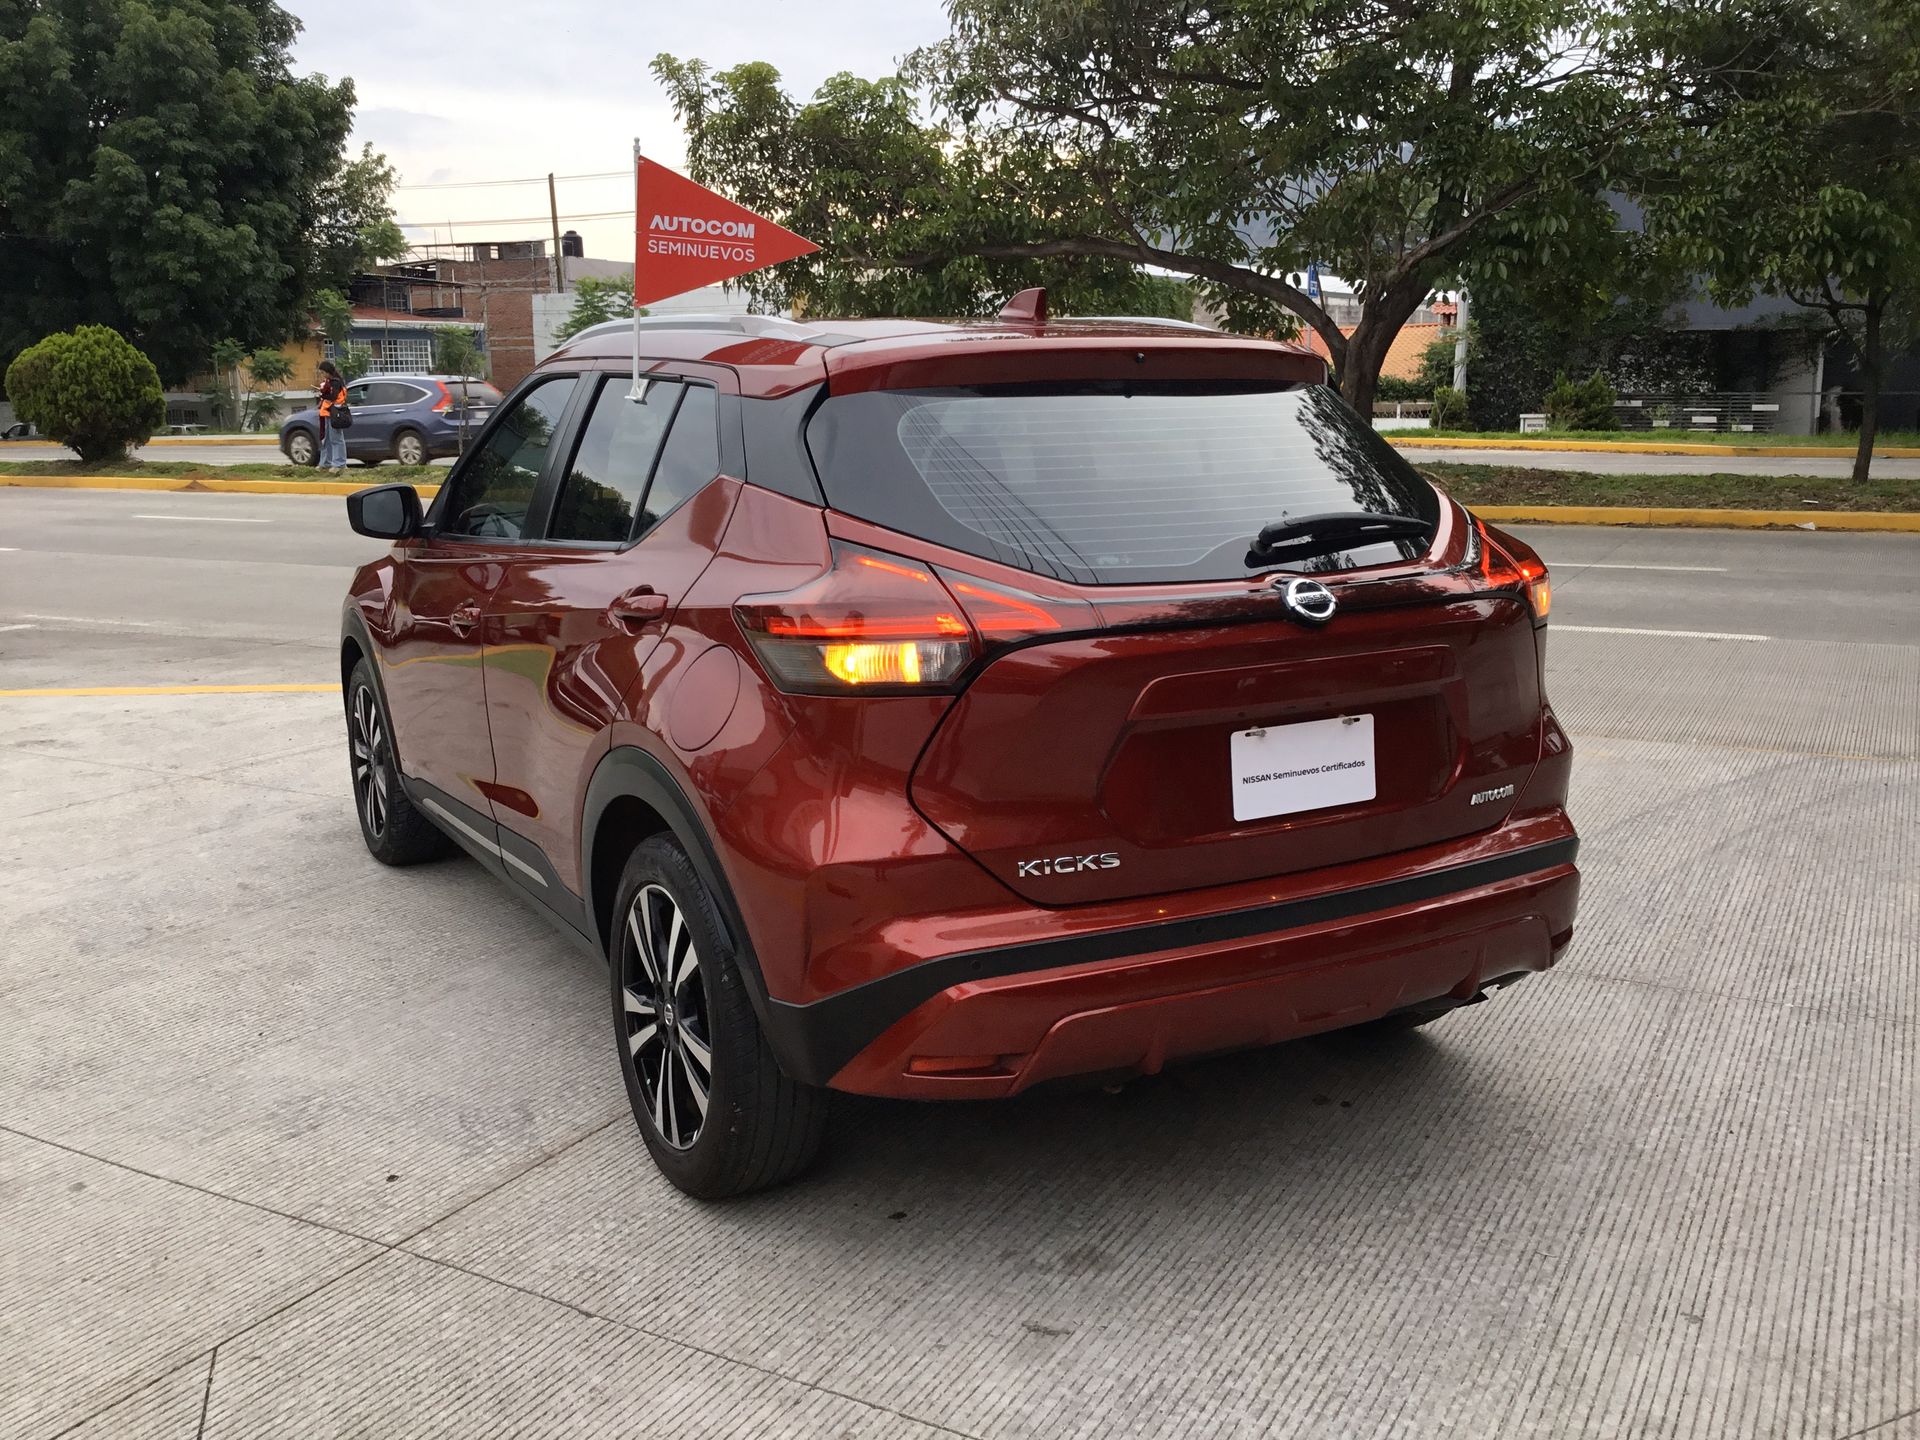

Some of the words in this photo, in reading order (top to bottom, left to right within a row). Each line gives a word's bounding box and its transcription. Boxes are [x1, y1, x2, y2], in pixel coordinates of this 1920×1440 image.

[650, 214, 756, 239] AUTOCOM
[647, 239, 756, 262] SEMINUEVOS
[1242, 773, 1272, 785] NISSAN
[1272, 767, 1320, 780] Seminuevos
[1321, 760, 1366, 773] Certificados
[1470, 784, 1514, 806] AUTOCOM
[1018, 852, 1121, 878] KICKS
